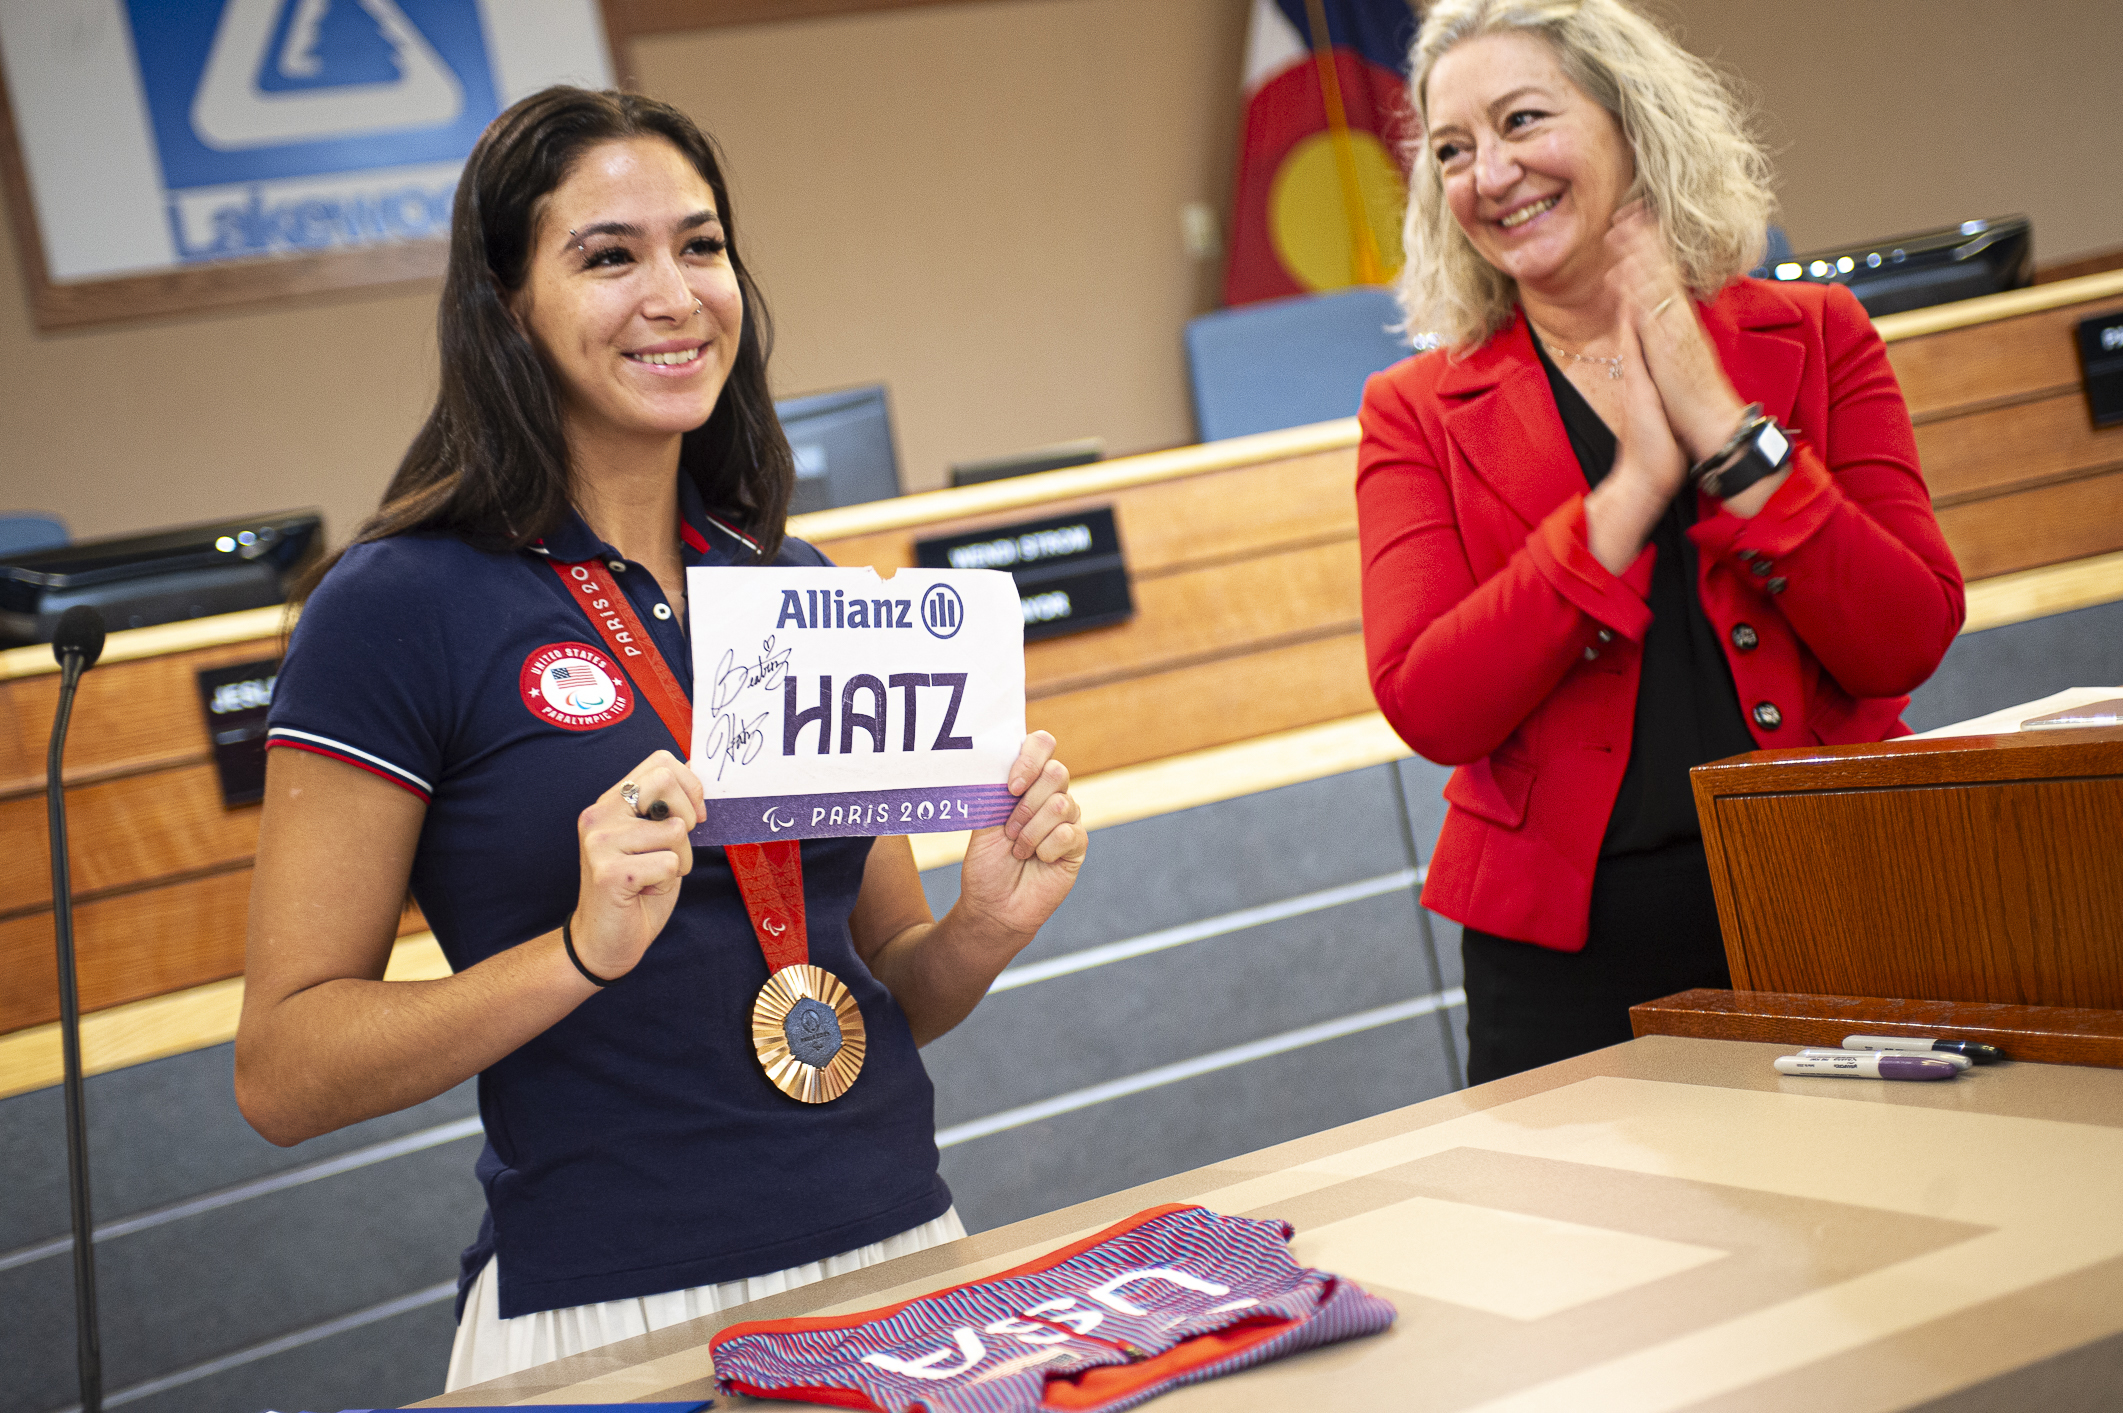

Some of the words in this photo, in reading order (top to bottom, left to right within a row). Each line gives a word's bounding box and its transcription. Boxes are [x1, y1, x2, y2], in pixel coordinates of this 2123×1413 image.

[776, 589, 913, 629] Allianz
[530, 649, 563, 675] UNITED
[564, 647, 607, 669] STATES
[541, 706, 612, 725] PARALYMPIC
[782, 673, 974, 756] HATZ
[900, 799, 969, 822] 2024
[860, 1267, 1231, 1380] USA
